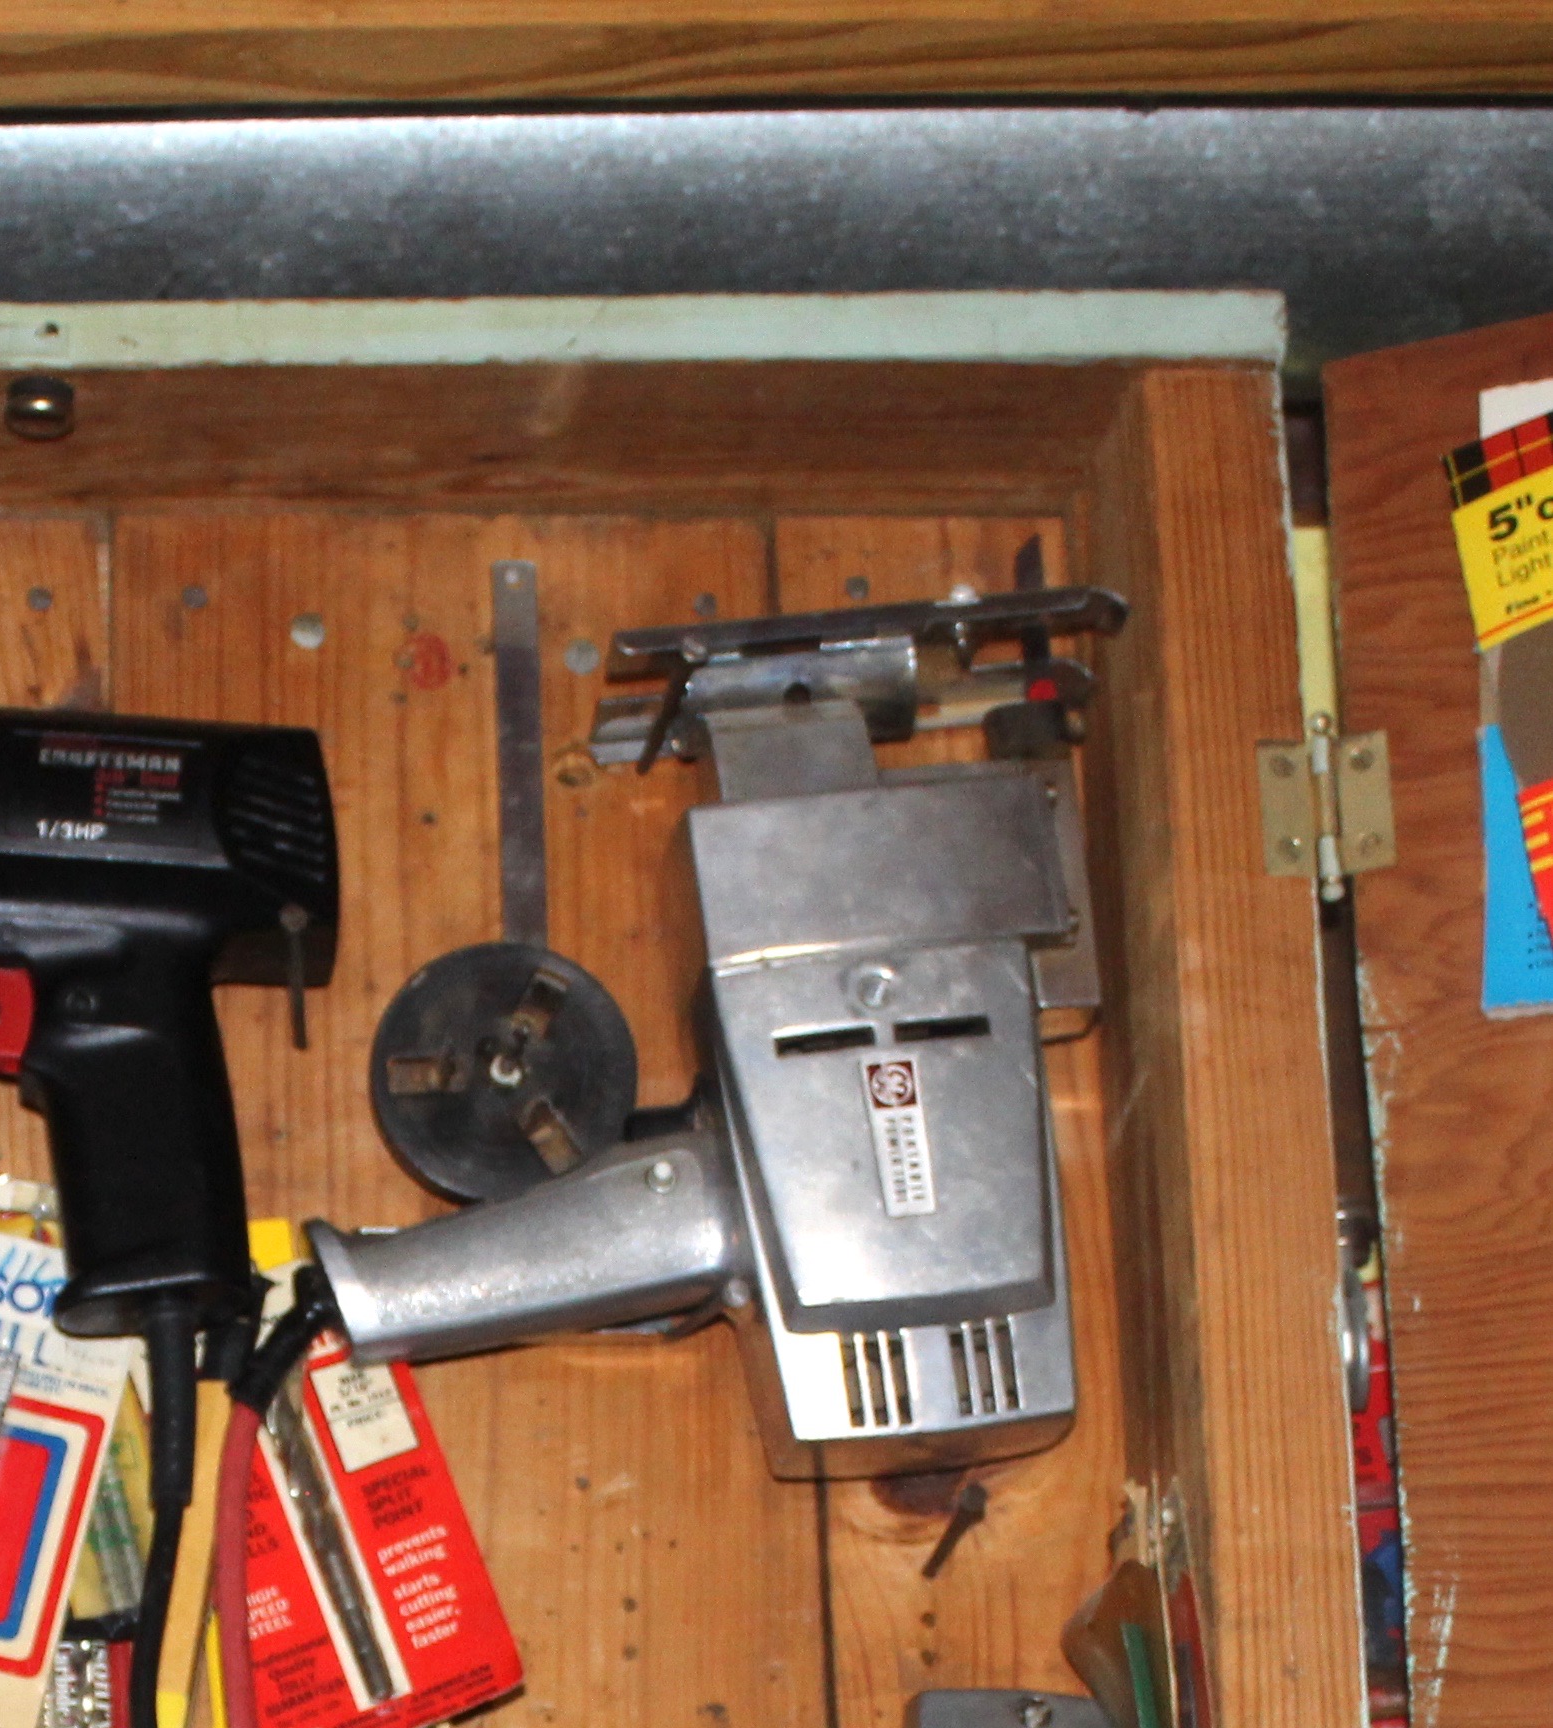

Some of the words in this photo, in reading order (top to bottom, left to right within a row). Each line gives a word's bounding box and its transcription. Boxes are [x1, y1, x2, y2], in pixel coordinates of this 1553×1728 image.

[377, 1525, 447, 1566] prevents
[383, 1543, 447, 1578] walking
[392, 1572, 441, 1601] starts
[399, 1583, 458, 1617] cutting
[410, 1620, 459, 1650] faster
